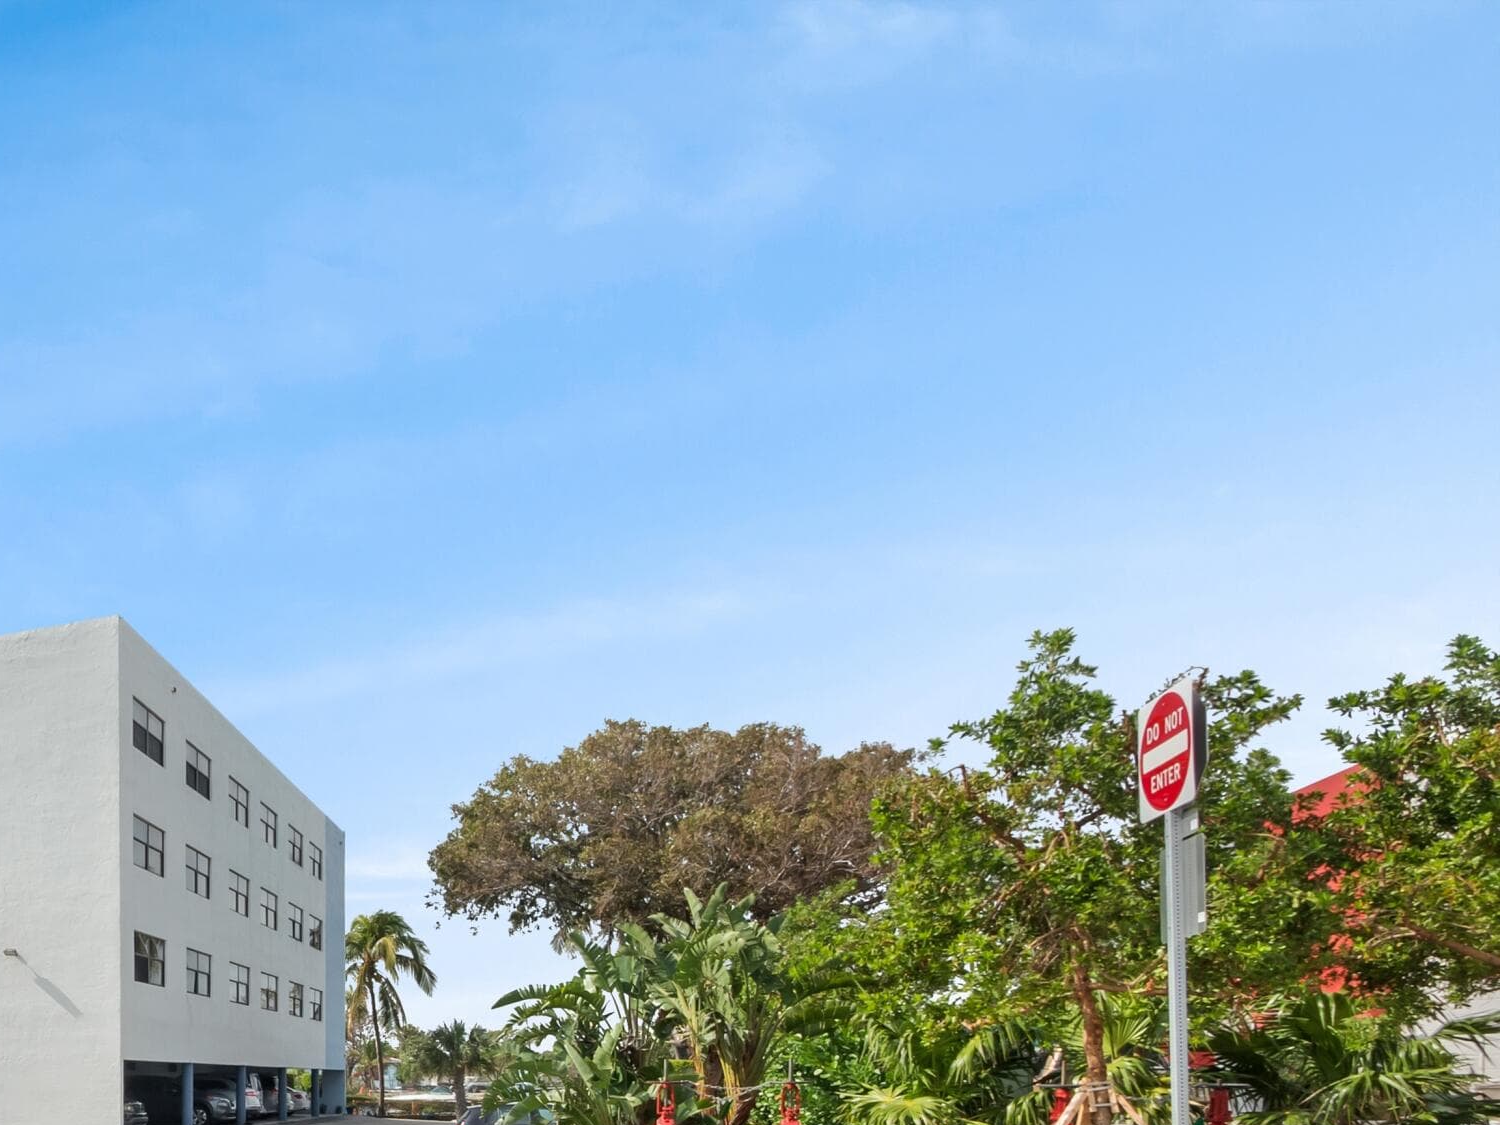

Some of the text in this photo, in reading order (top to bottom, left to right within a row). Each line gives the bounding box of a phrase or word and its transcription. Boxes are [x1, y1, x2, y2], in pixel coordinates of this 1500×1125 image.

[1146, 706, 1184, 745] DO NOT
[1150, 763, 1181, 794] ENTER
